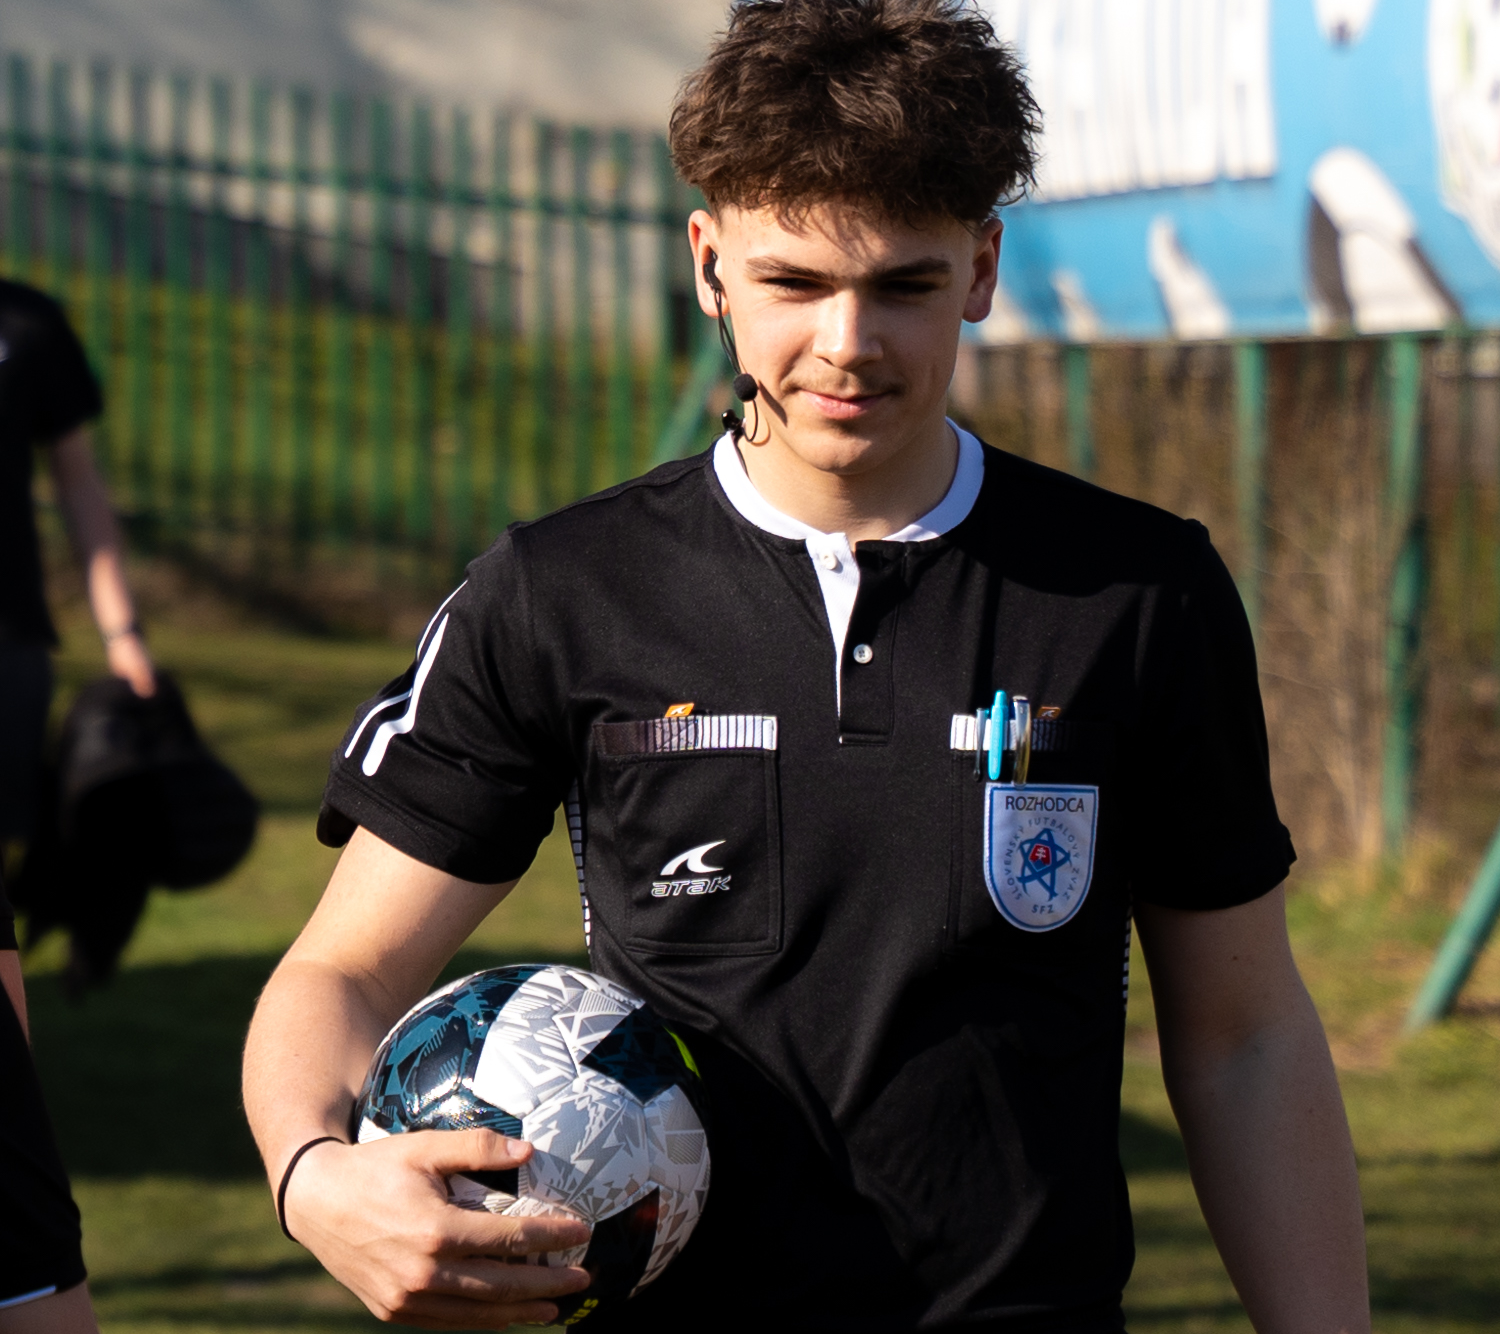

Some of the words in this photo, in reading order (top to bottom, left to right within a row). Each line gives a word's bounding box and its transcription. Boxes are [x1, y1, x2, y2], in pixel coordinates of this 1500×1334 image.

[1005, 795, 1084, 813] ROZHODCA
[1031, 904, 1055, 915] SFZ
[560, 1298, 599, 1326] eus
